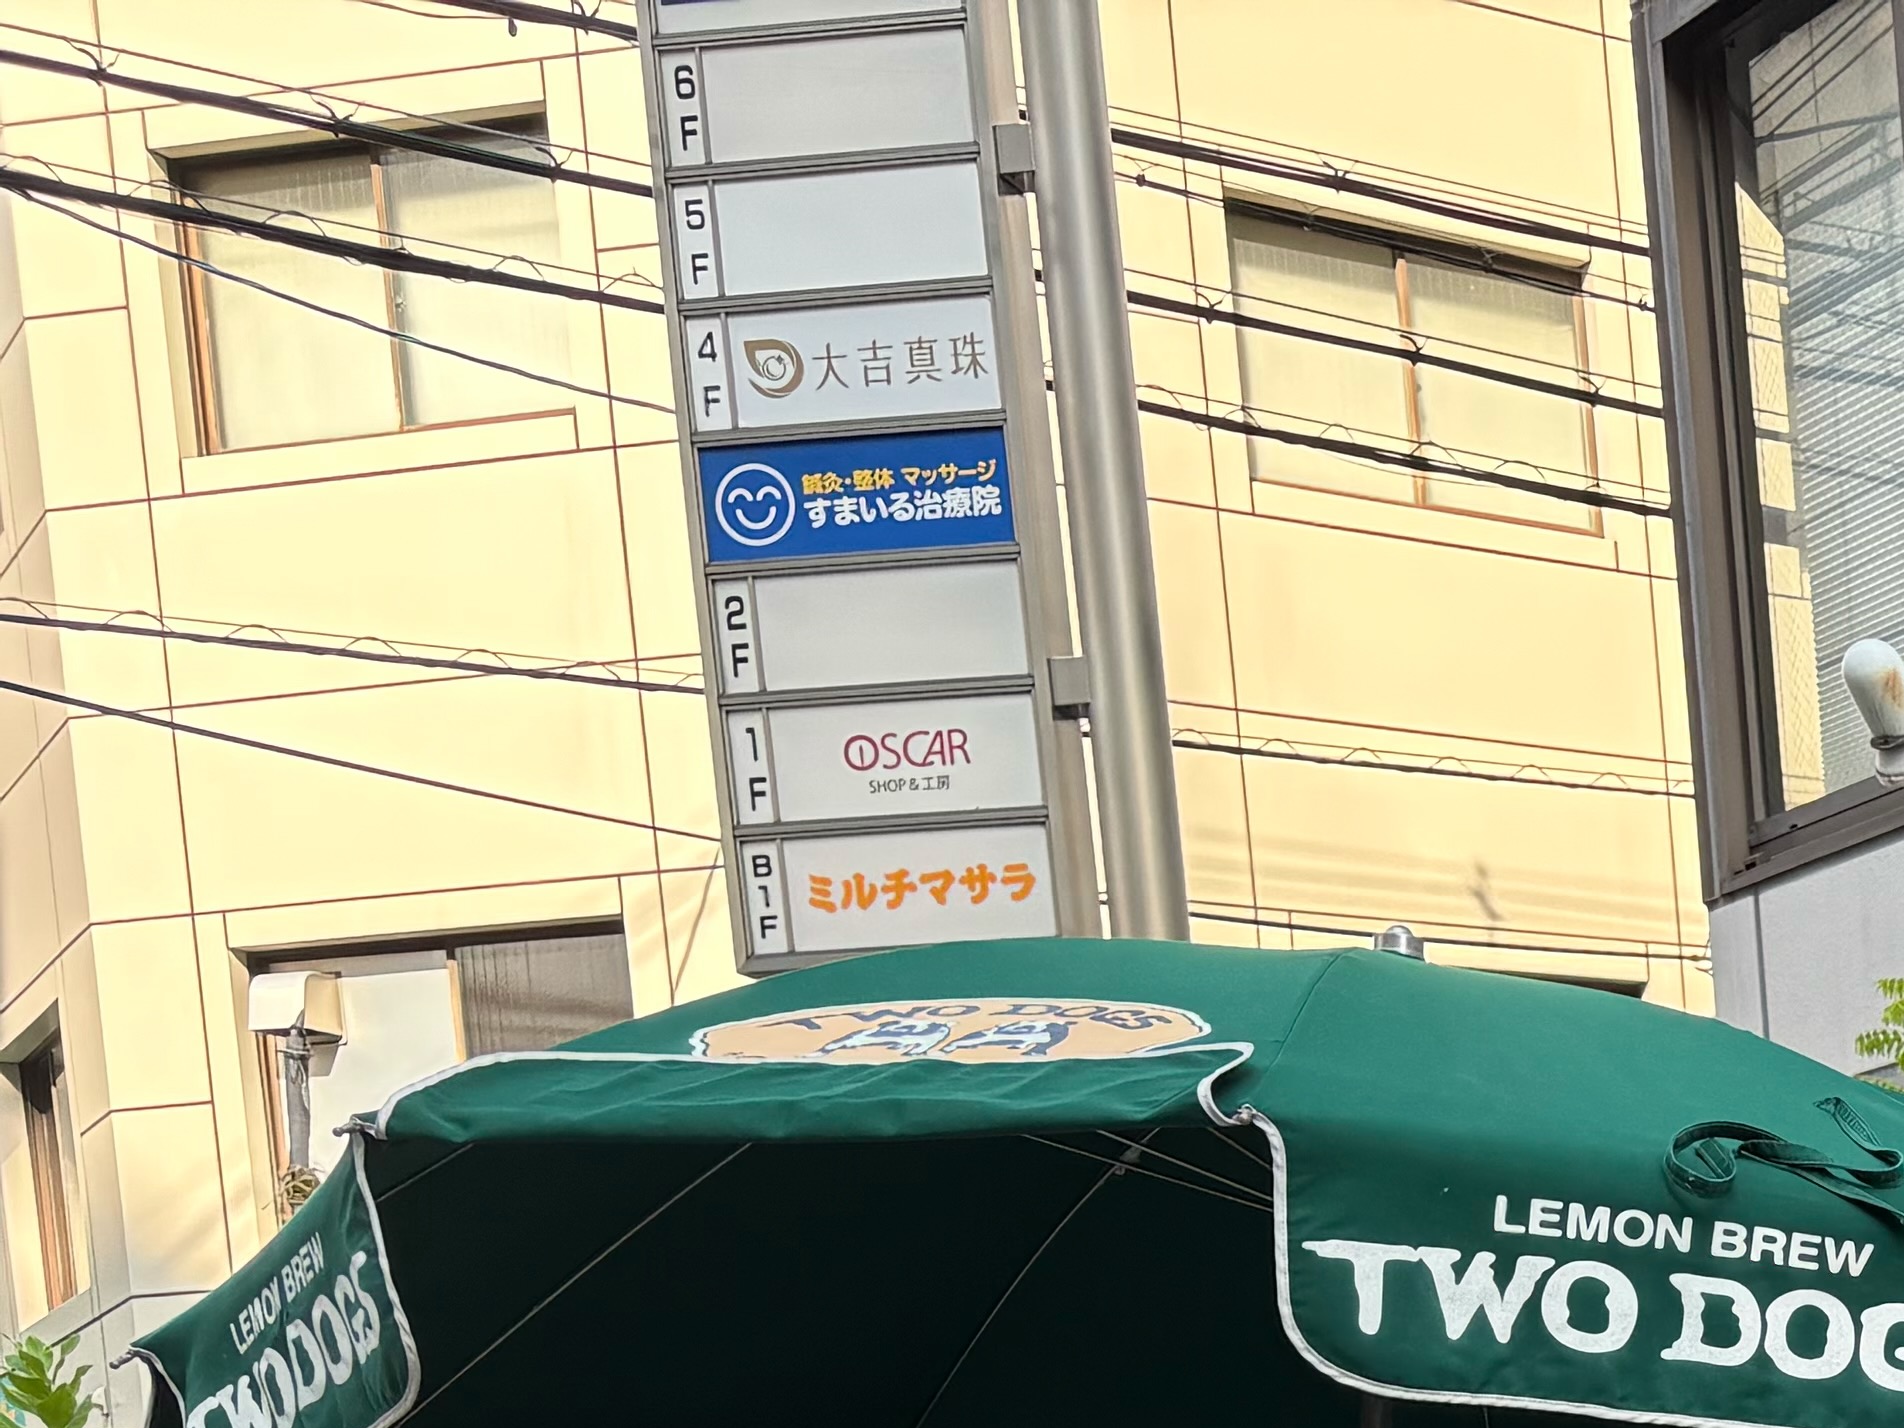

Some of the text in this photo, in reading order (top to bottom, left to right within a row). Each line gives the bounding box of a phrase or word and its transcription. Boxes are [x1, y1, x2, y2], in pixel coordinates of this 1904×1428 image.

[812, 330, 992, 394] 大吉真珠
[803, 484, 1002, 528] すまいる治療院
[844, 728, 971, 771] OSCAR
[808, 862, 1036, 914] ミルチマサラ
[1492, 1194, 1876, 1278] LEMON BREW
[229, 1231, 328, 1357] LEMON BREW
[281, 1250, 382, 1412] DOGS
[1301, 1237, 1640, 1355] TWO
